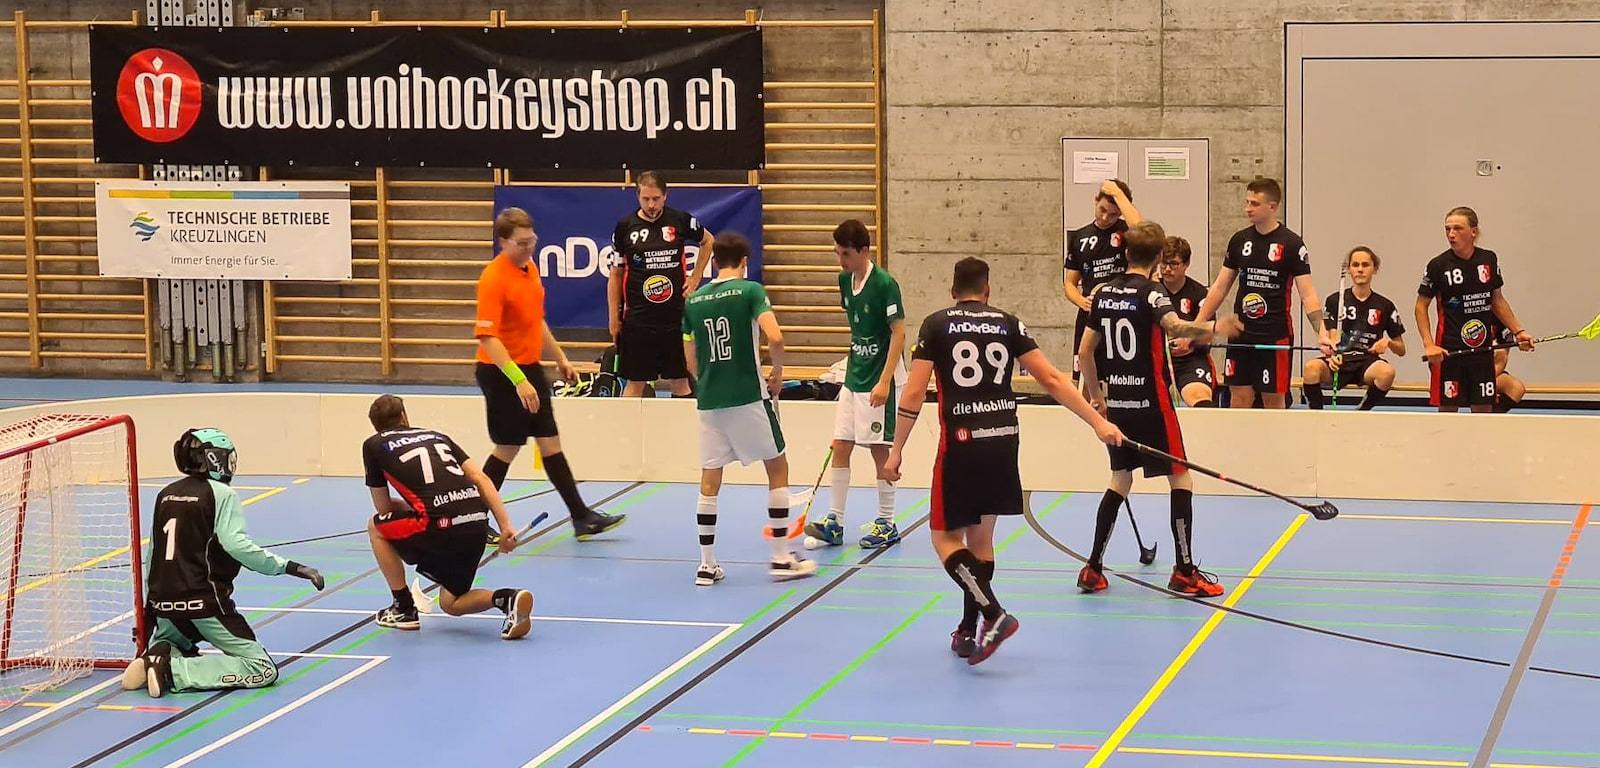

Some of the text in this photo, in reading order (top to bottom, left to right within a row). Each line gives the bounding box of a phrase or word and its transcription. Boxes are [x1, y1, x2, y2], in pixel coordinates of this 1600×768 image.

[218, 63, 737, 139] www.unihockeyshop.ch
[168, 211, 331, 225] TECHNISCHE BETRIEBE
[170, 229, 267, 244] KREUZLINGEN
[630, 228, 650, 244] 99
[1080, 235, 1099, 252] 79
[1242, 241, 1253, 257] 8
[171, 255, 279, 268] Immer Energie für Sie.
[1445, 268, 1464, 286] 18
[703, 317, 732, 363] 12
[1101, 317, 1136, 361] 10
[952, 340, 1009, 387] 89
[1195, 367, 1213, 384] 96
[1262, 369, 1270, 384] 8
[1479, 381, 1495, 398] 18
[398, 443, 464, 484] 75
[162, 517, 177, 561] 1
